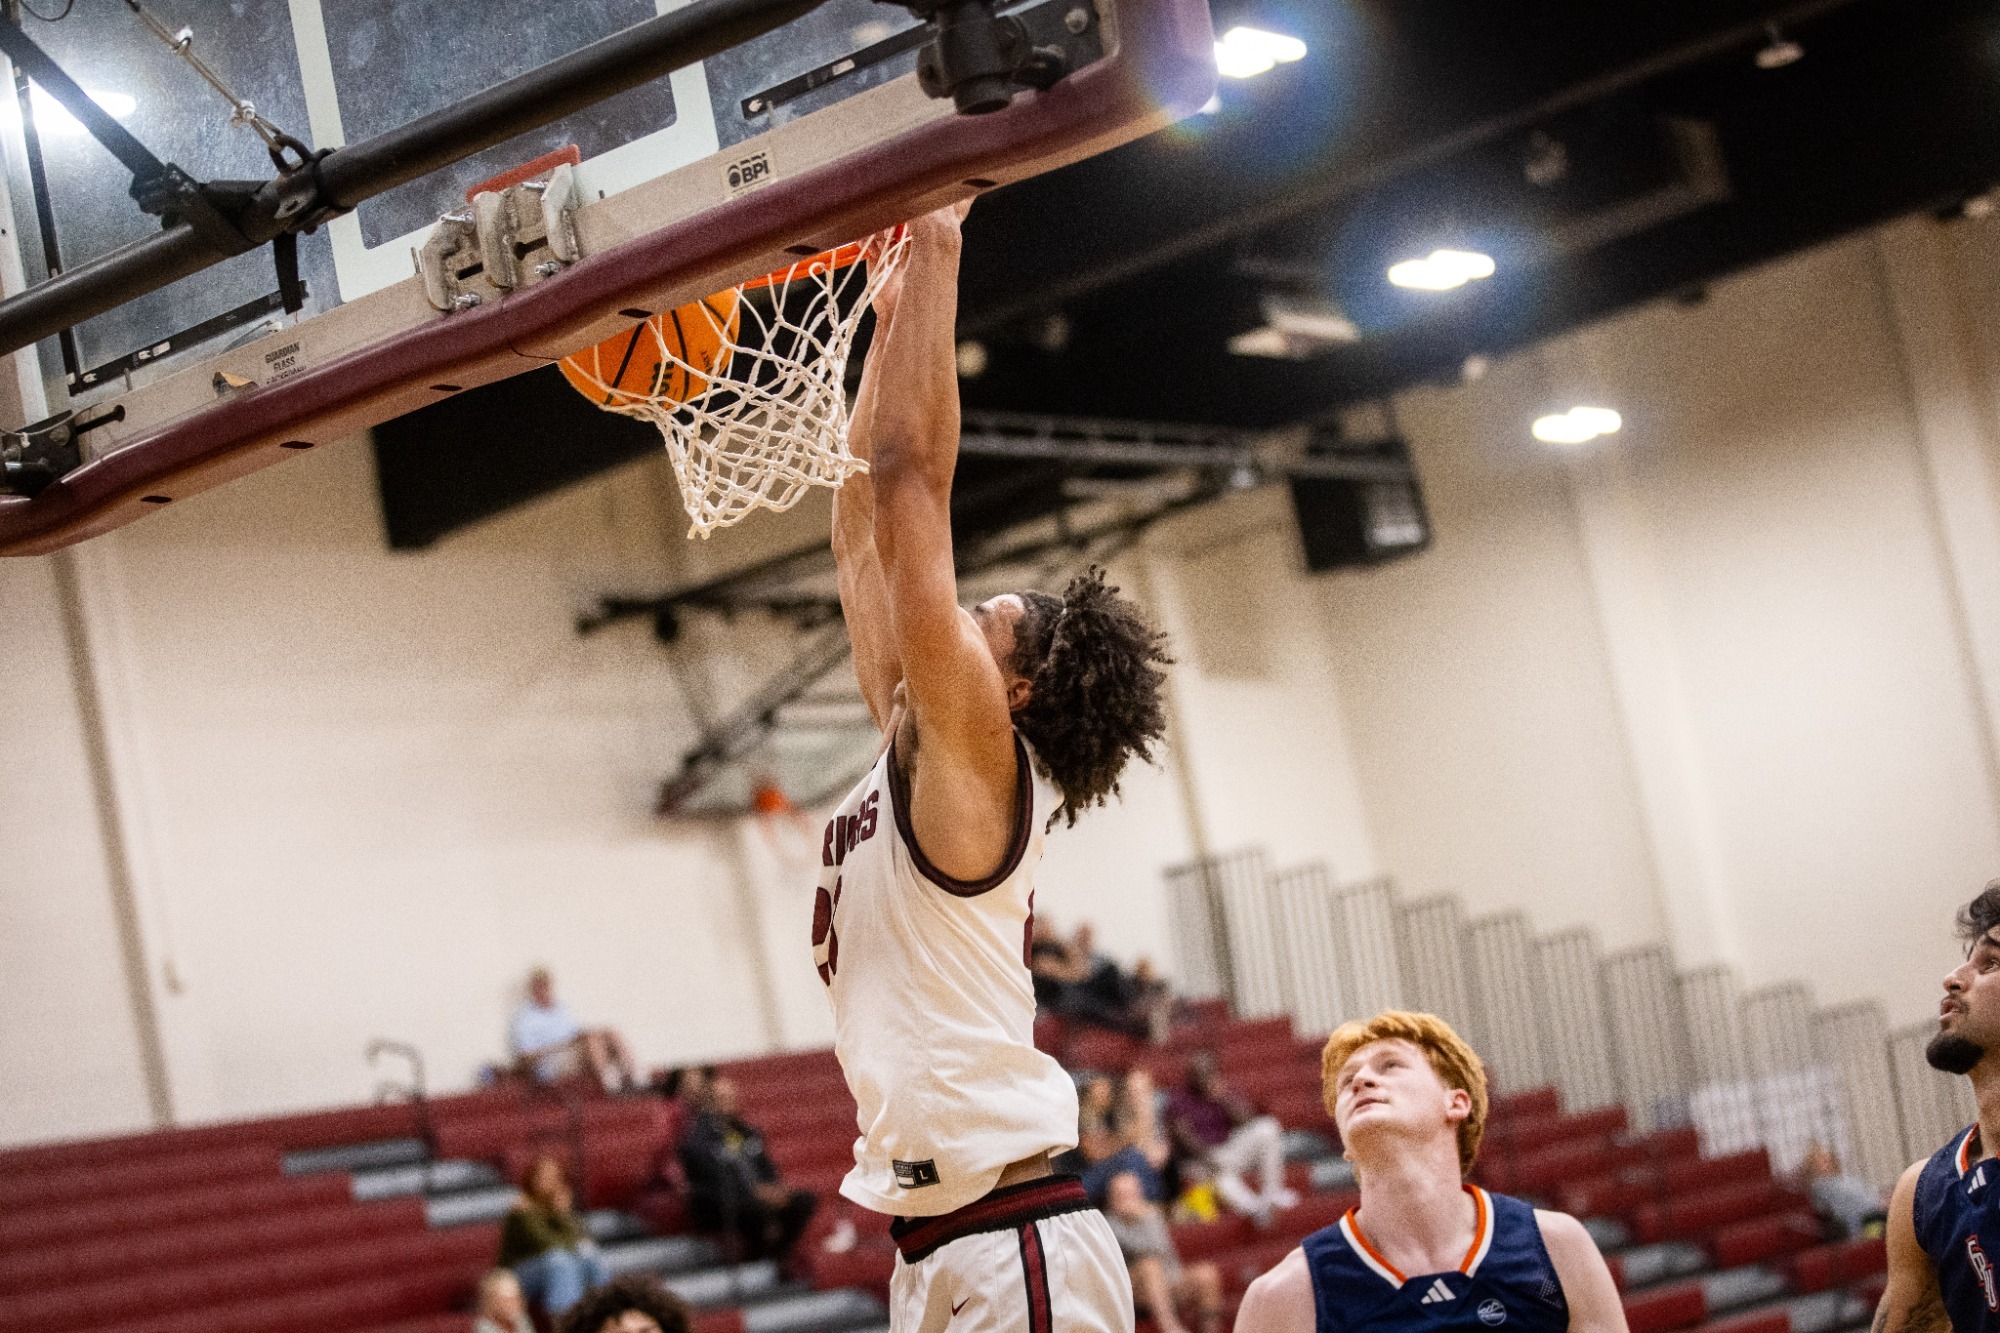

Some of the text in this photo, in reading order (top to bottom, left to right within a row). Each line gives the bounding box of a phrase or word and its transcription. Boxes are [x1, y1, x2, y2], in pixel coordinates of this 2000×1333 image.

[741, 160, 769, 183] BPI
[265, 342, 300, 363] GUARDIAN
[273, 356, 296, 372] GLASS
[919, 1169, 928, 1180] L
